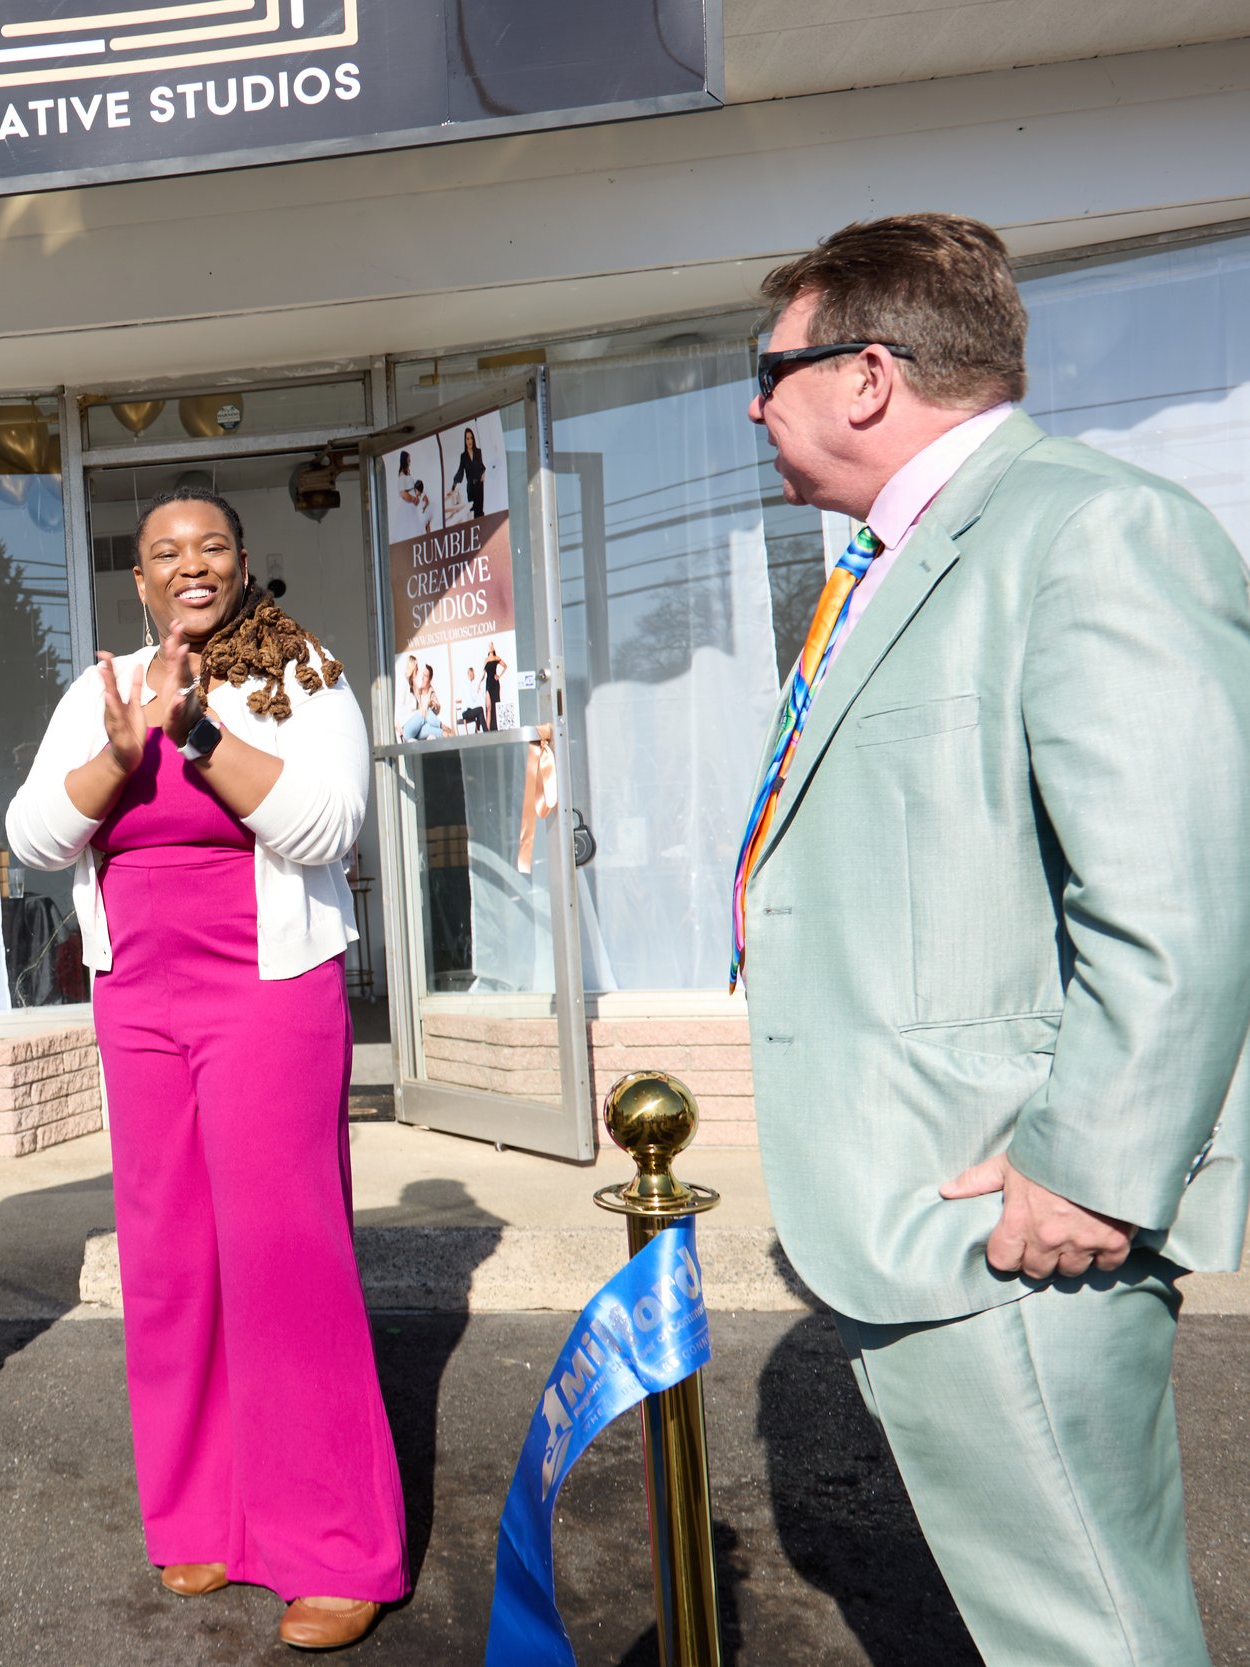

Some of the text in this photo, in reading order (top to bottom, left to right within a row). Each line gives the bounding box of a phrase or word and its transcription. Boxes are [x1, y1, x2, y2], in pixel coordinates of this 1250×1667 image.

[150, 62, 360, 123] STUDIOS
[413, 525, 481, 567] RUMBLE
[407, 555, 491, 598] CREATIVE
[412, 589, 487, 628] STUDIOS
